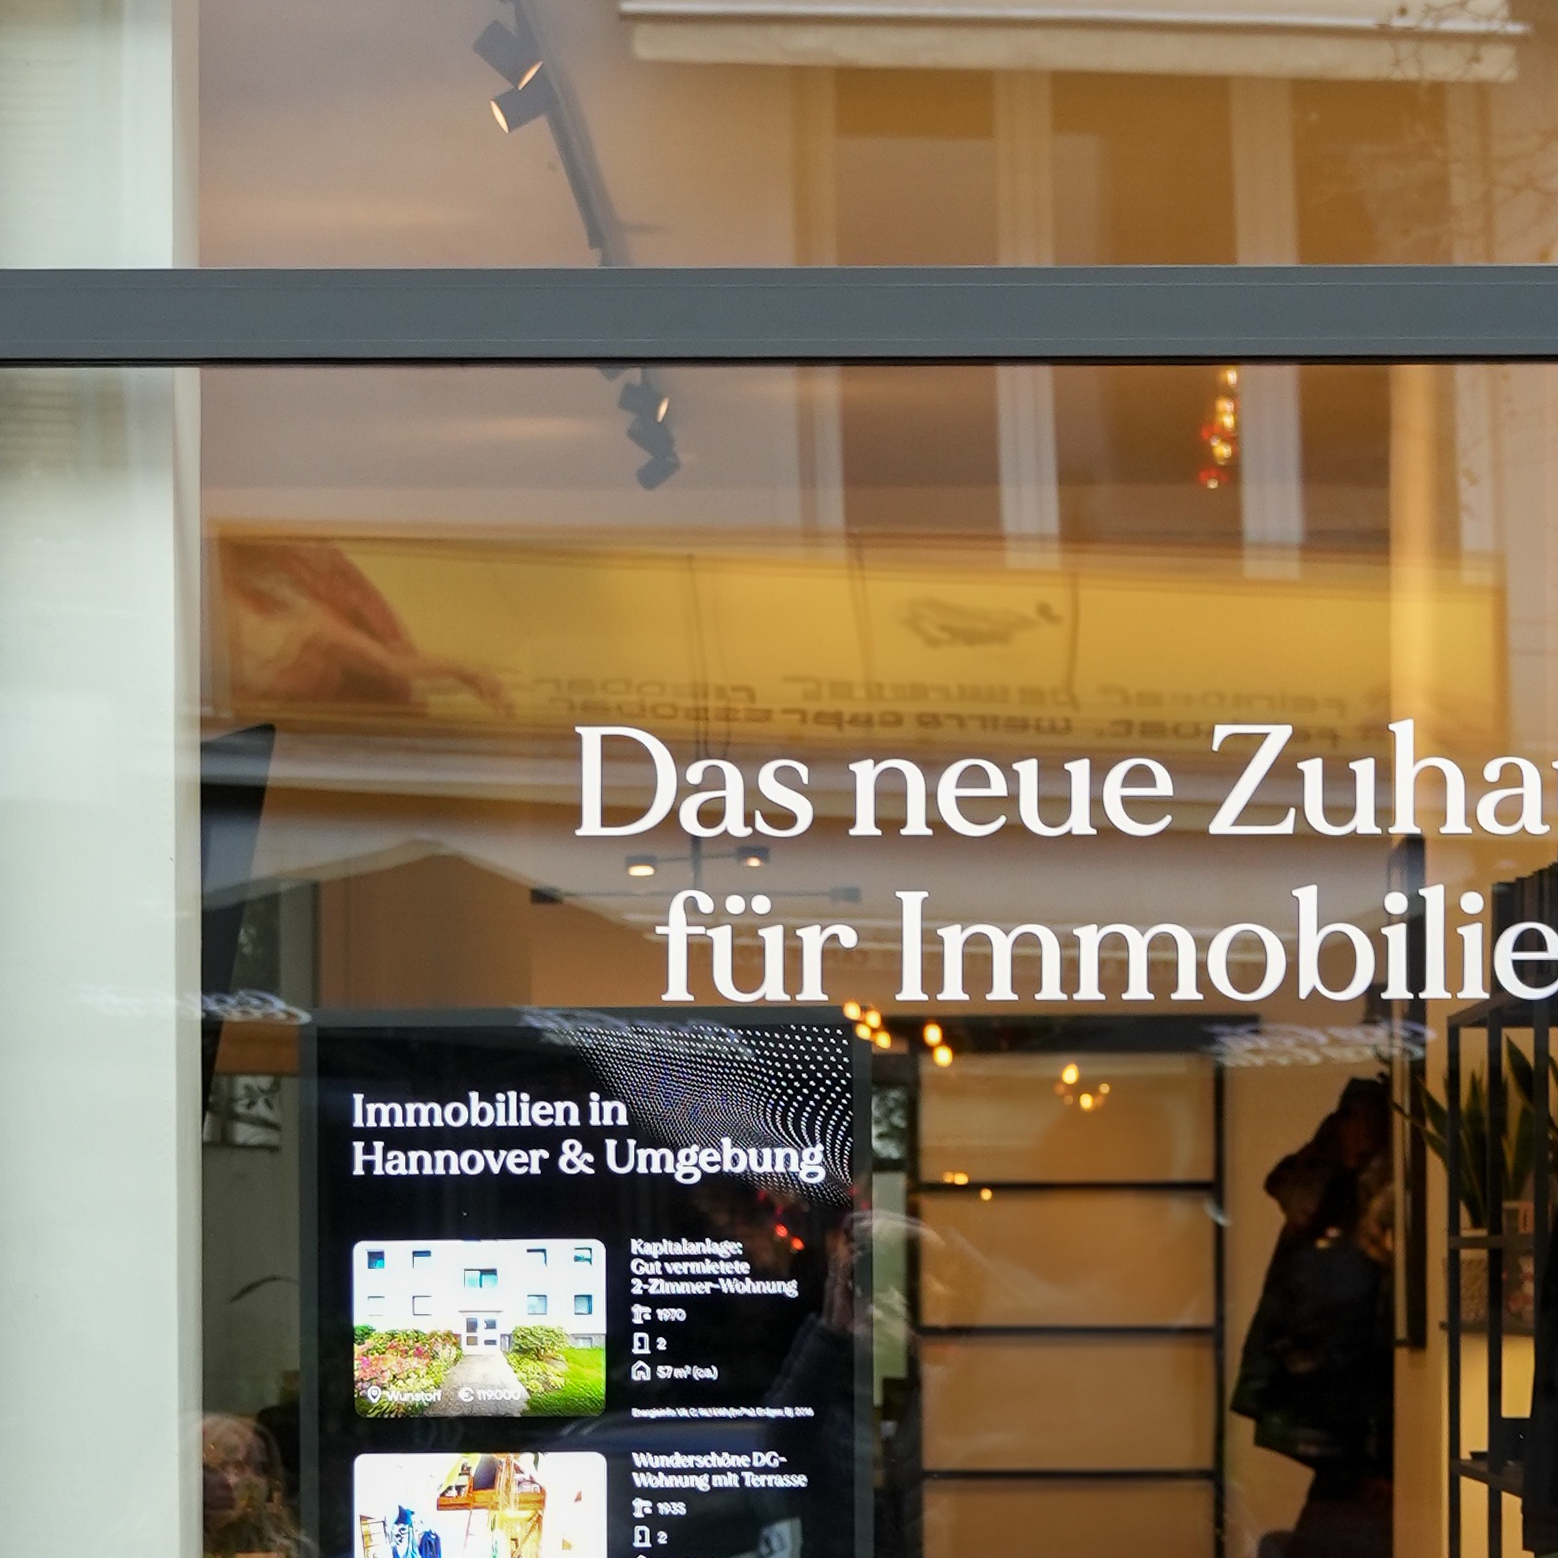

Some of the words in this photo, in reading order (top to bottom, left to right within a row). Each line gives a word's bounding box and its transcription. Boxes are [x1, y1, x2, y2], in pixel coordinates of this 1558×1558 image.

[574, 726, 813, 838] Das
[848, 757, 1174, 837] neue
[654, 887, 858, 1003] für
[352, 1090, 581, 1128] Immobilien
[589, 1091, 629, 1127] in
[352, 1140, 550, 1176] Hannover
[558, 1139, 595, 1175] &
[605, 1136, 827, 1184] Umgebung
[630, 1237, 743, 1259] Kapitalanlage:
[630, 1258, 663, 1275] Gut
[664, 1258, 751, 1275] vermietete
[630, 1277, 799, 1298] 2-Zimmer-Wohnung
[656, 1336, 667, 1351] 2
[631, 1451, 751, 1469] Wunderschöne
[751, 1451, 788, 1469] DG-
[631, 1471, 711, 1492] Wohnung
[711, 1471, 740, 1488] mit
[740, 1471, 808, 1488] Terrasse
[656, 1530, 668, 1545] 2
